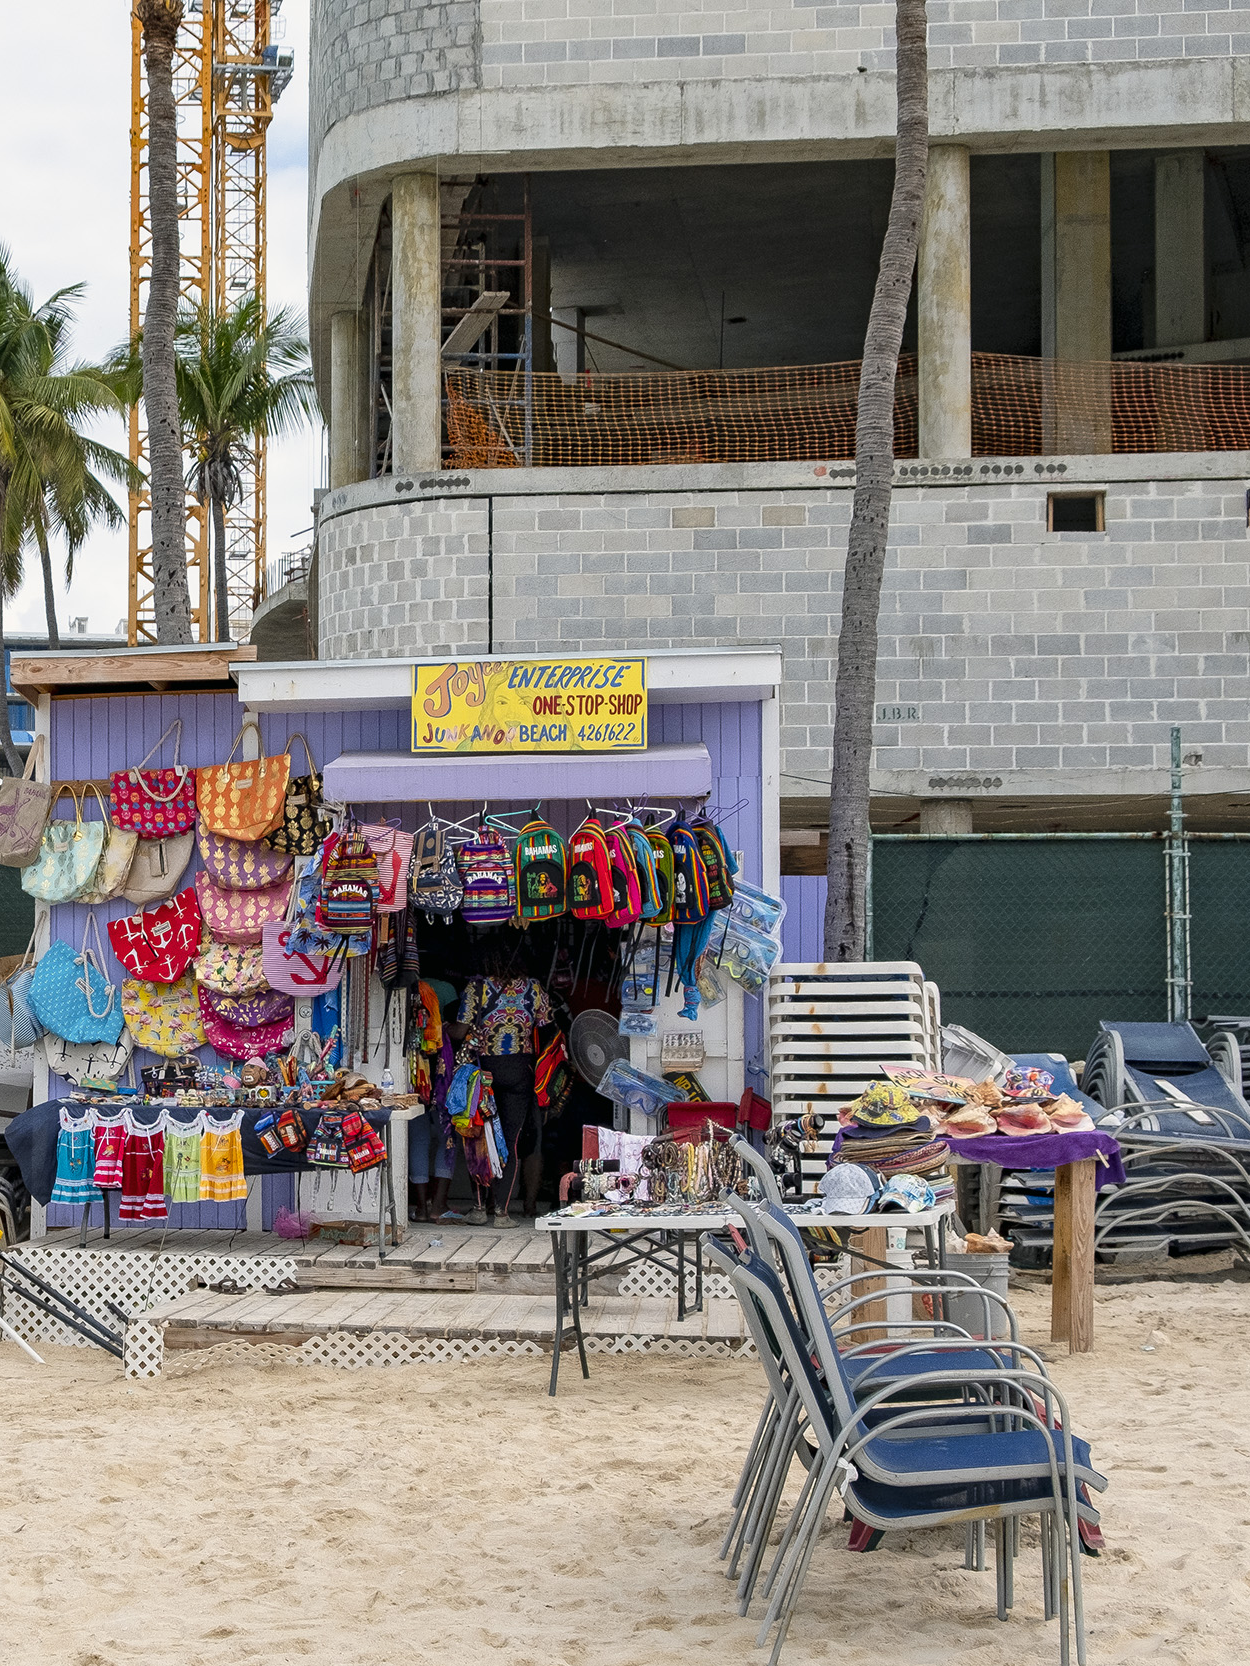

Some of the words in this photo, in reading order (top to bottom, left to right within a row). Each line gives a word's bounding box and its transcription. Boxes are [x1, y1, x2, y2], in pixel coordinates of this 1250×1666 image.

[532, 693, 643, 717] ONE-STOP-SHOP
[422, 723, 518, 746] JUNKANOO
[519, 724, 567, 743] BEACH
[578, 722, 636, 743] 4261622
[524, 844, 558, 856] BAHAMAS
[466, 870, 503, 885] BAHAMAS
[332, 884, 369, 898] BAHAMAS
[673, 1075, 692, 1091] NP
